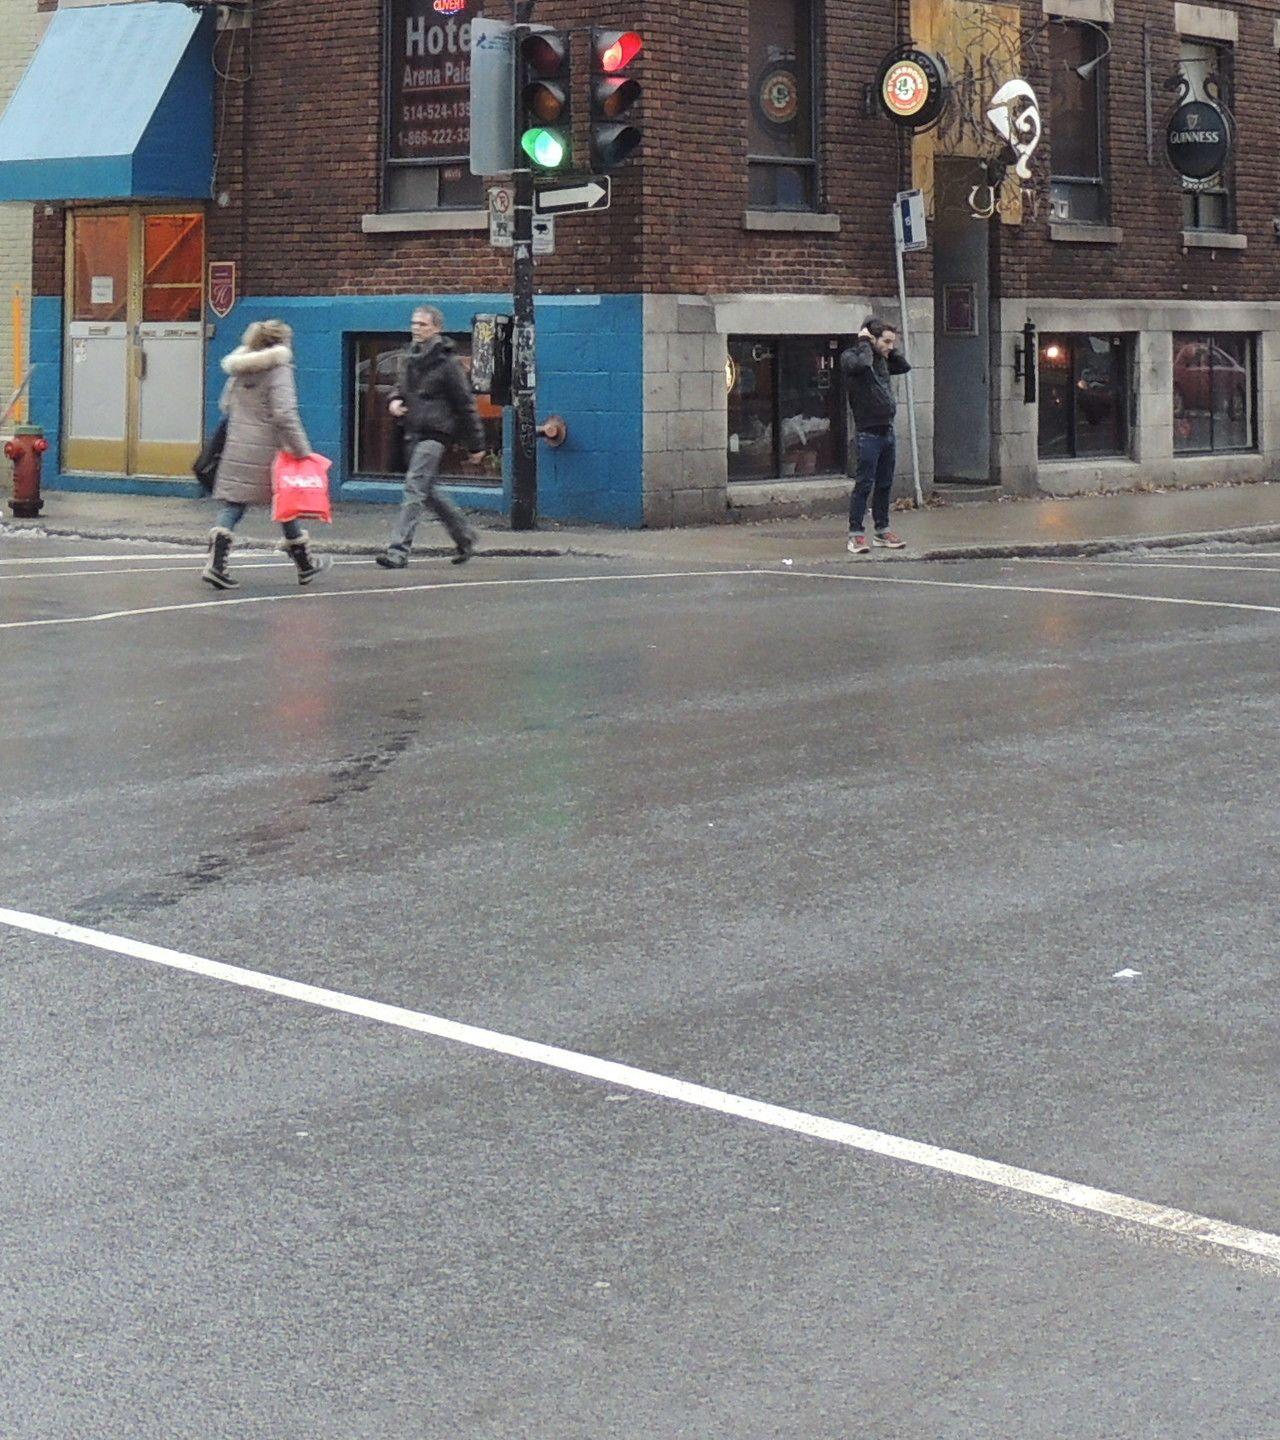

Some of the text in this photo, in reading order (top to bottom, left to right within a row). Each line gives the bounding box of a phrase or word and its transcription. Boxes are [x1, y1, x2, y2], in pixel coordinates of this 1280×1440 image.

[405, 15, 470, 57] Hote
[402, 60, 470, 88] Arena Pala
[403, 102, 470, 121] 514-524-13
[1171, 131, 1219, 143] GUINNESS
